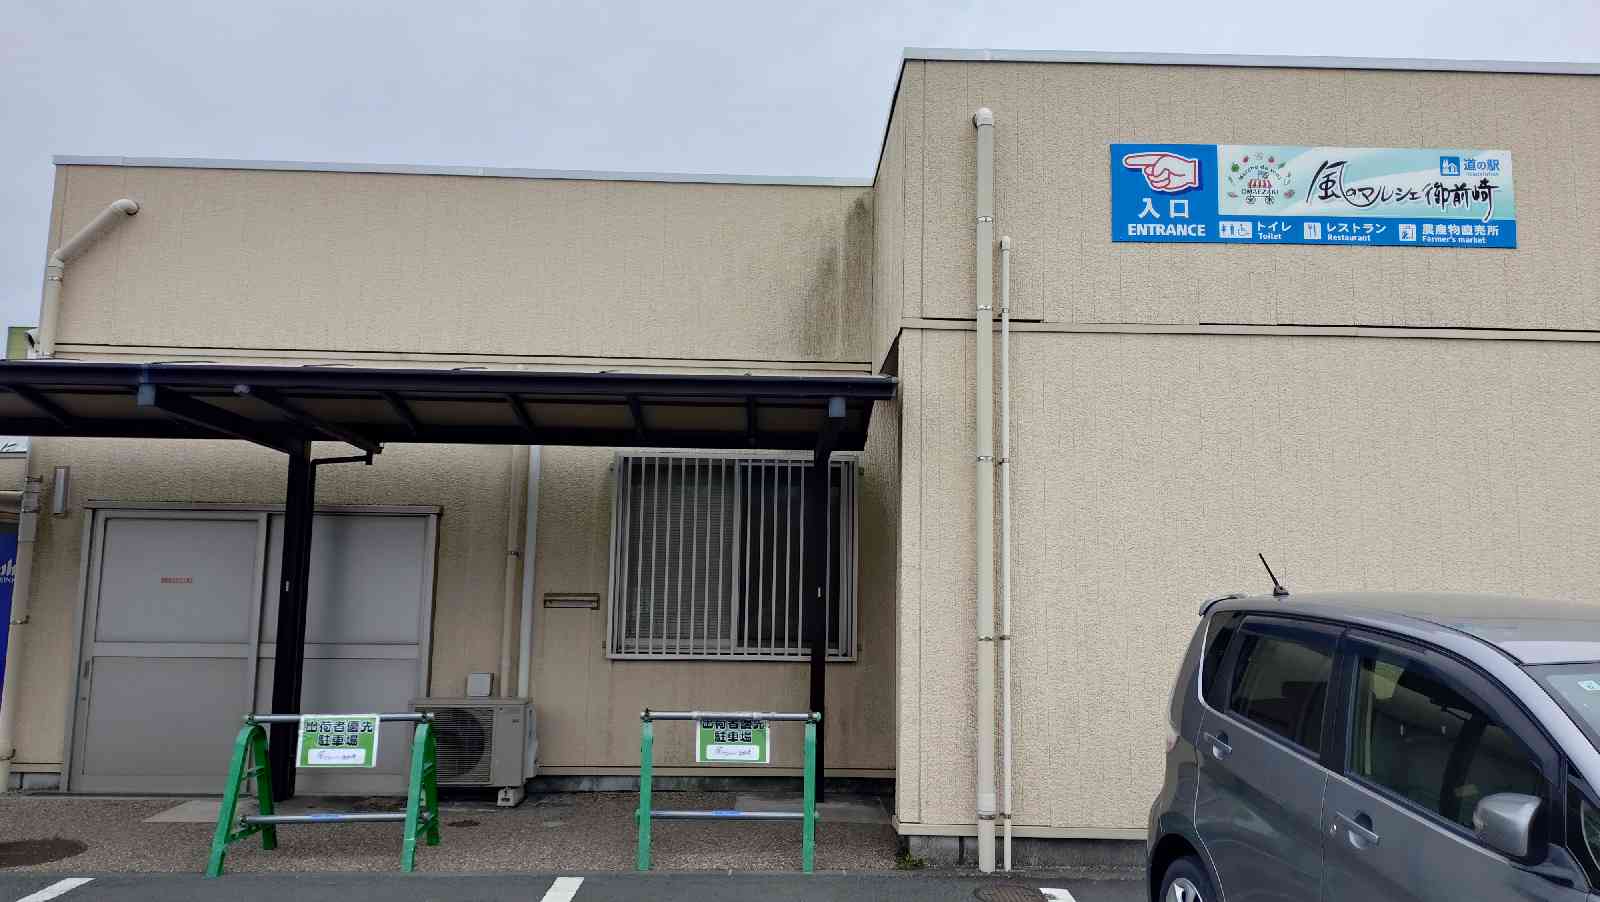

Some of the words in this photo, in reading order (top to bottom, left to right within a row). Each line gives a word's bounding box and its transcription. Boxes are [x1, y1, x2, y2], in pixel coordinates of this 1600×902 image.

[1463, 158, 1500, 171] 道の駅
[1138, 197, 1189, 218] 入口
[1127, 223, 1207, 237] ENTRANCE
[1257, 221, 1293, 232] トイレ
[1327, 222, 1387, 234] レストラン
[1422, 223, 1500, 236] 農産物直売所
[1258, 232, 1282, 240] Toilet
[1327, 234, 1371, 242] Restaurant
[319, 735, 358, 746] 駐車場
[715, 731, 752, 742] 駐車場
